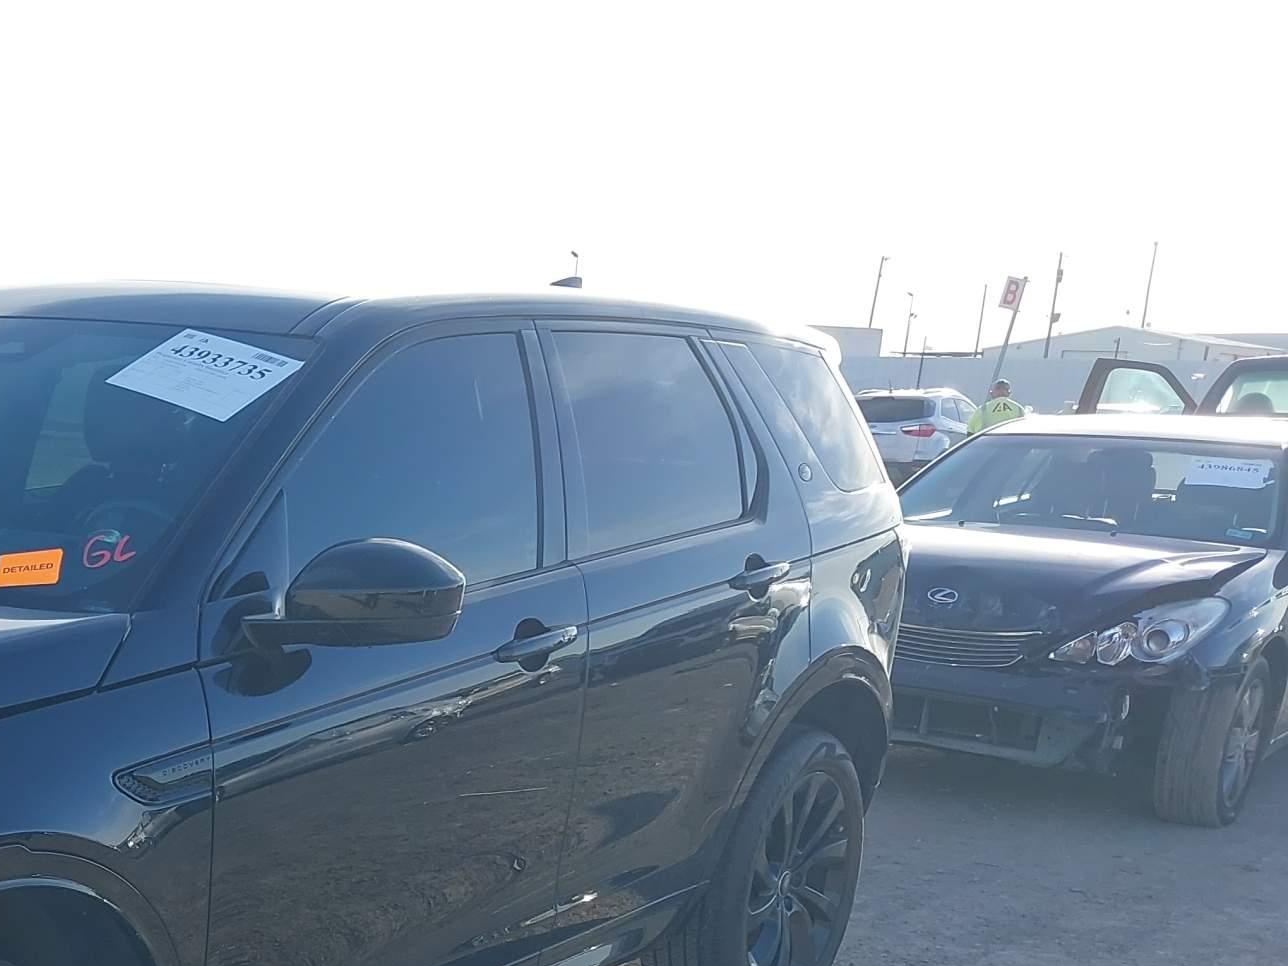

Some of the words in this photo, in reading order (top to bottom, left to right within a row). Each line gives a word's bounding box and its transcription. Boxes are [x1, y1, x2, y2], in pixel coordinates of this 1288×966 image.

[1002, 280, 1019, 305] B
[170, 344, 273, 381] 43933735
[2, 562, 54, 574] DETAILED
